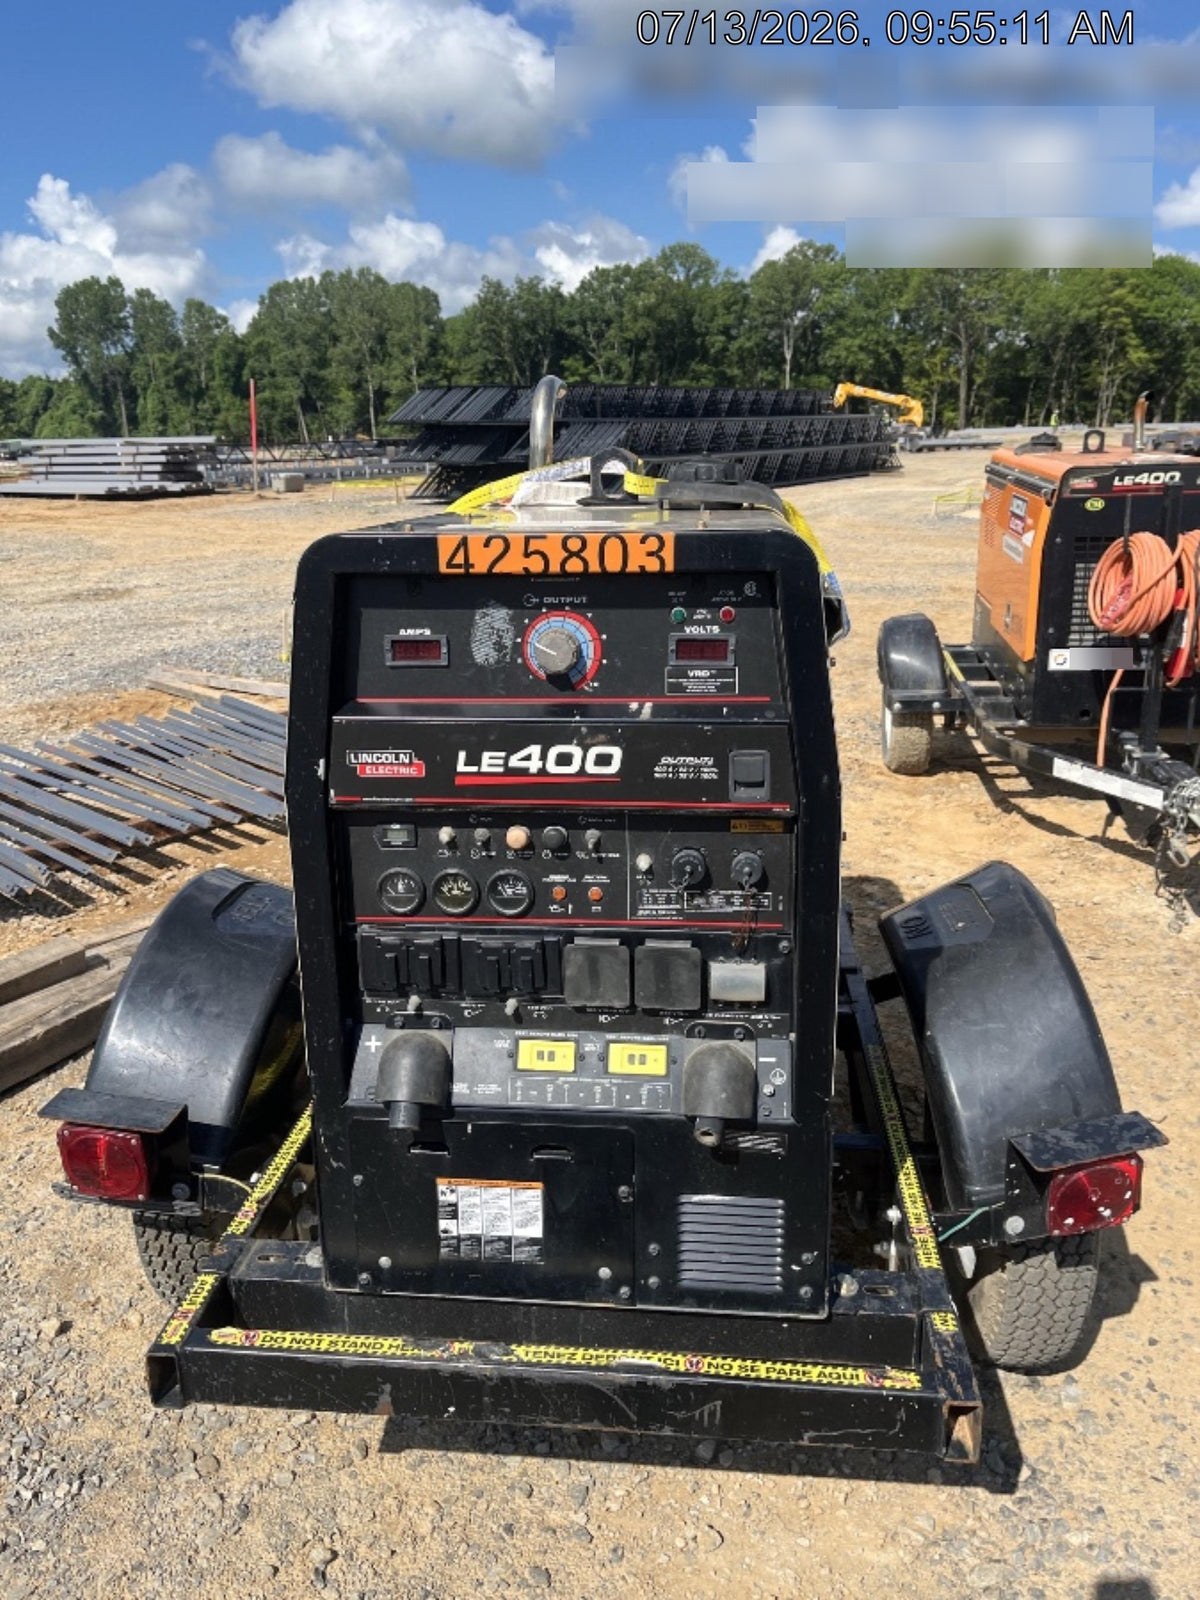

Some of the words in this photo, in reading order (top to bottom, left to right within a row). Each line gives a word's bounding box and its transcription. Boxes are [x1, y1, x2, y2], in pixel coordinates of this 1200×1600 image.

[1113, 471, 1182, 487] LE400
[445, 534, 666, 575] 425803
[543, 596, 588, 604] OUTPUT
[399, 627, 432, 637] AMPS
[684, 625, 721, 635] VOLTS
[349, 752, 411, 765] LINCOLN
[455, 744, 623, 775] LE400
[365, 765, 419, 775] ELECTRIC
[260, 1334, 287, 1344] DO
[289, 1336, 324, 1346] NOT
[327, 1338, 386, 1350] STAND
[706, 1361, 733, 1372] NO
[737, 1363, 761, 1374] SE
[765, 1366, 813, 1378] PARE
[816, 1369, 860, 1382] AQUI
